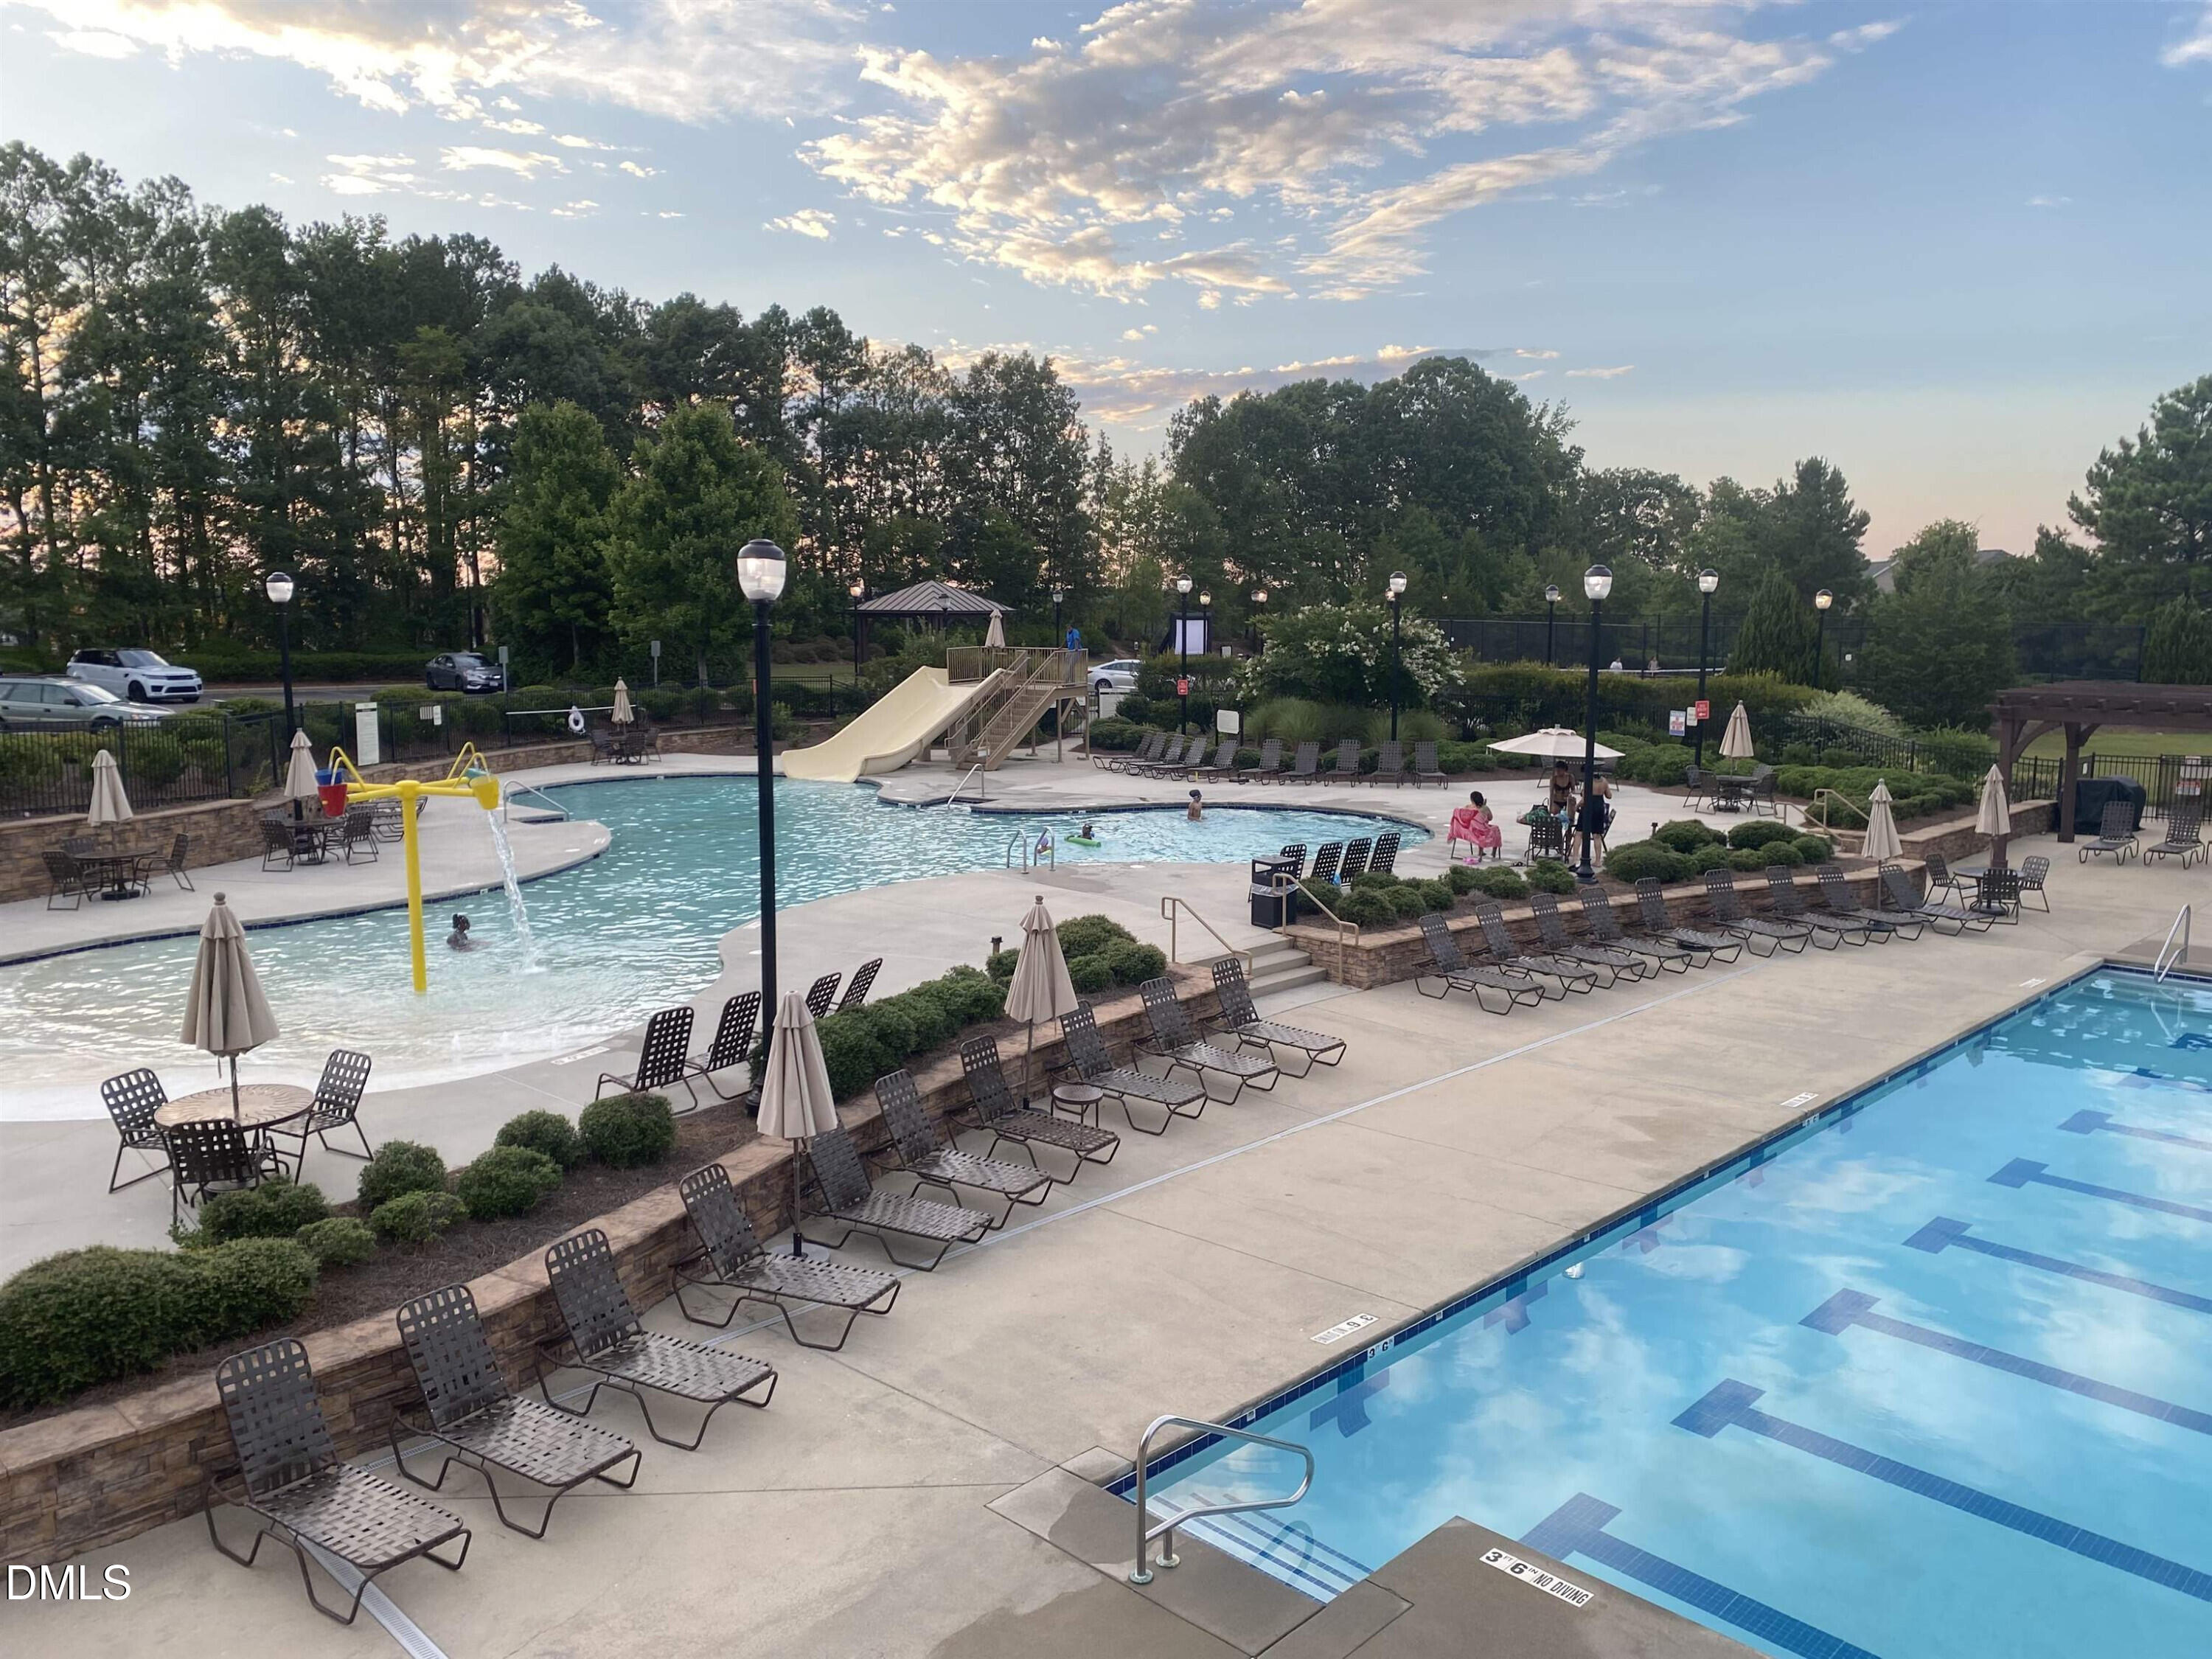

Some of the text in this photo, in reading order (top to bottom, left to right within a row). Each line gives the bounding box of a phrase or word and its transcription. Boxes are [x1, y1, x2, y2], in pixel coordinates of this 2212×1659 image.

[1485, 1551, 1503, 1562] 3
[1510, 1562, 1528, 1575] 6
[1534, 1573, 1553, 1587] NO
[1550, 1582, 1590, 1604] DIVING
